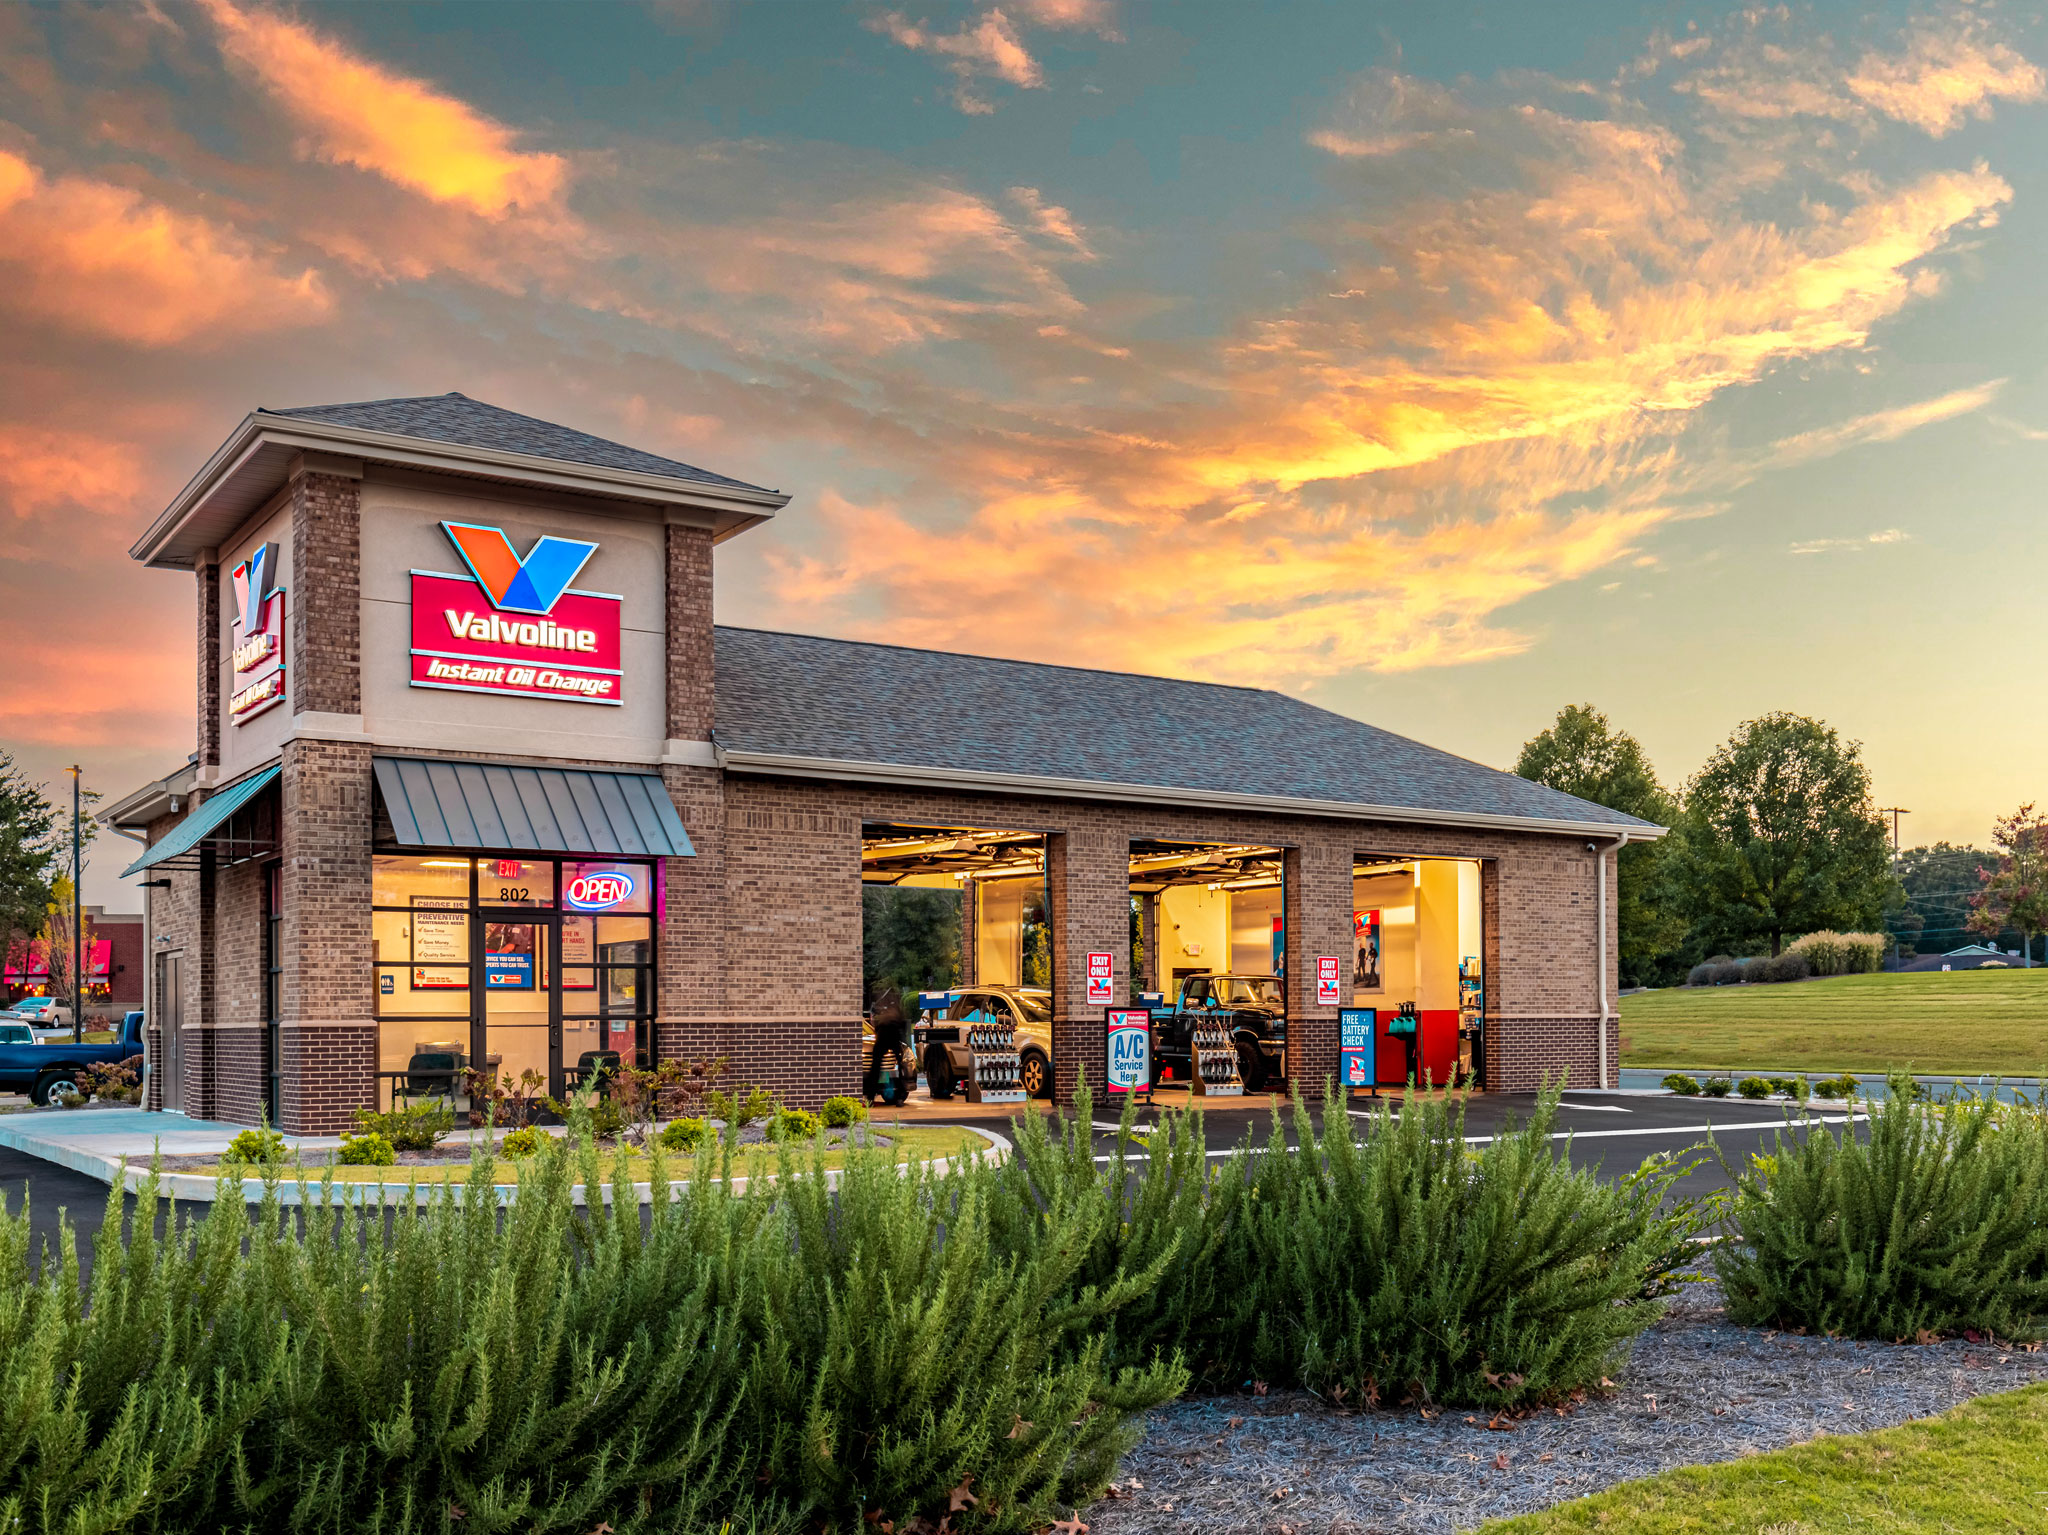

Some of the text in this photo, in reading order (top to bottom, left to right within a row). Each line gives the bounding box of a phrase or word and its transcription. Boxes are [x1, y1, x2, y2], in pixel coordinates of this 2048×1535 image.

[445, 609, 596, 652] Valvoline
[426, 660, 612, 695] Instant Oil Change
[499, 861, 518, 877] EXIT
[500, 888, 529, 901] 802
[570, 879, 626, 902] OPEN
[1092, 956, 1108, 965] EXIT
[1322, 960, 1336, 969] EXIT
[1091, 966, 1109, 976] ONLY
[1321, 970, 1336, 978] ONLY
[1342, 1014, 1359, 1024] FREE
[1342, 1025, 1369, 1035] BATTERY
[1342, 1036, 1364, 1046] CHECK
[1114, 1034, 1144, 1059] A/C
[1114, 1060, 1143, 1070] Service
[1120, 1071, 1138, 1082] Here
